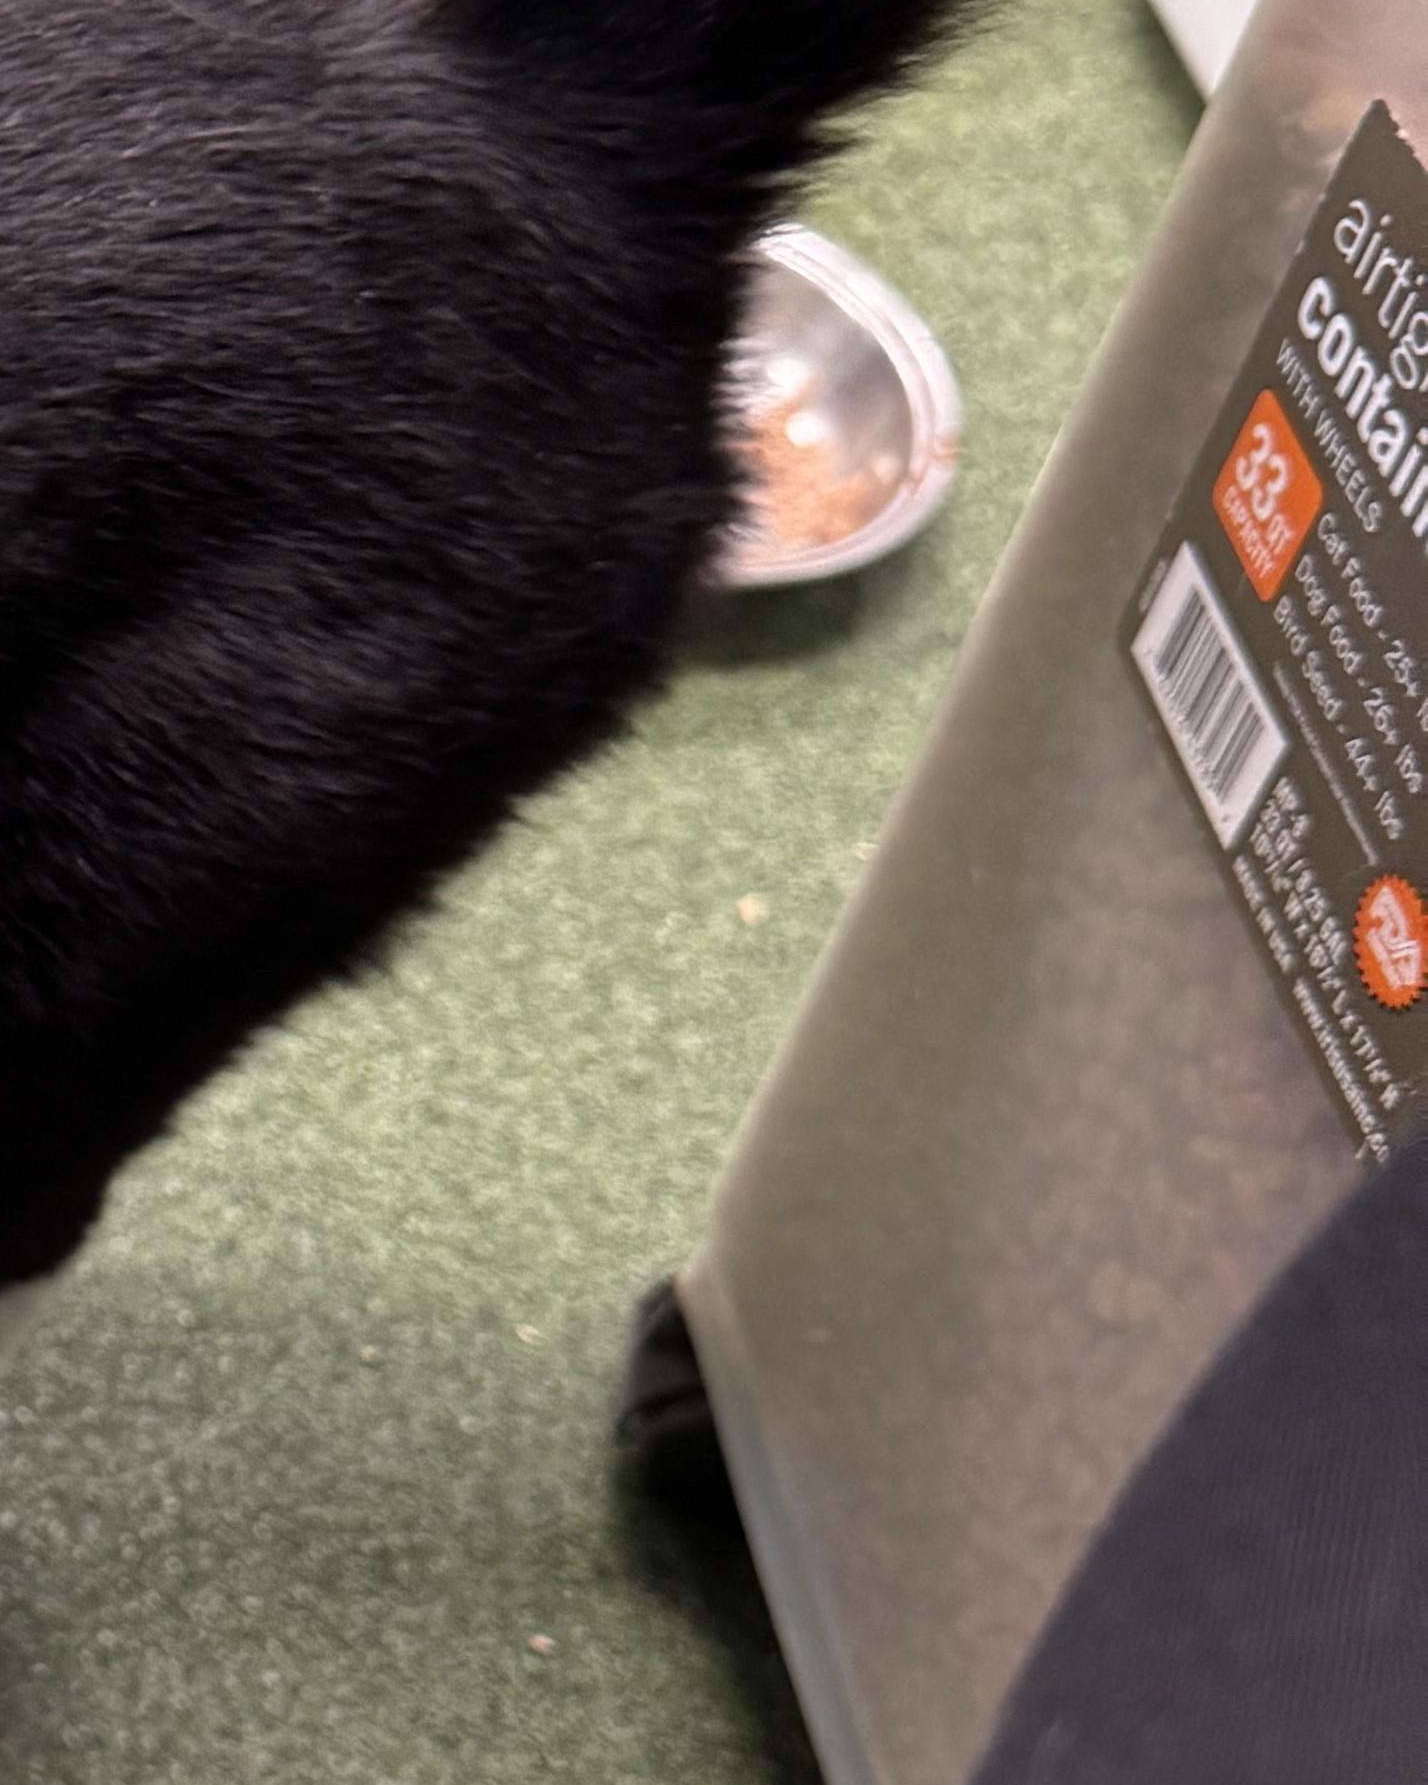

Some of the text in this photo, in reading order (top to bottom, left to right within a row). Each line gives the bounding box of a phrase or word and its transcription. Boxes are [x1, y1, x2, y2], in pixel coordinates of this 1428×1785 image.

[1334, 200, 1428, 392] airtig
[1236, 423, 1293, 555] 33 QT
[1276, 338, 1381, 532] WITH WHEELS
[1223, 485, 1274, 578] CAPACITY
[1318, 513, 1348, 565] Cat
[1342, 557, 1384, 627] Food
[1383, 639, 1420, 697] 25+
[1274, 595, 1309, 656] Bird
[1302, 650, 1343, 721] Seed
[1345, 738, 1377, 792] 44+
[1374, 791, 1403, 840] lbs
[1295, 555, 1326, 615] Dog
[1321, 605, 1363, 674] Food
[1363, 687, 1398, 744] 26+
[1394, 744, 1423, 793] lbs
